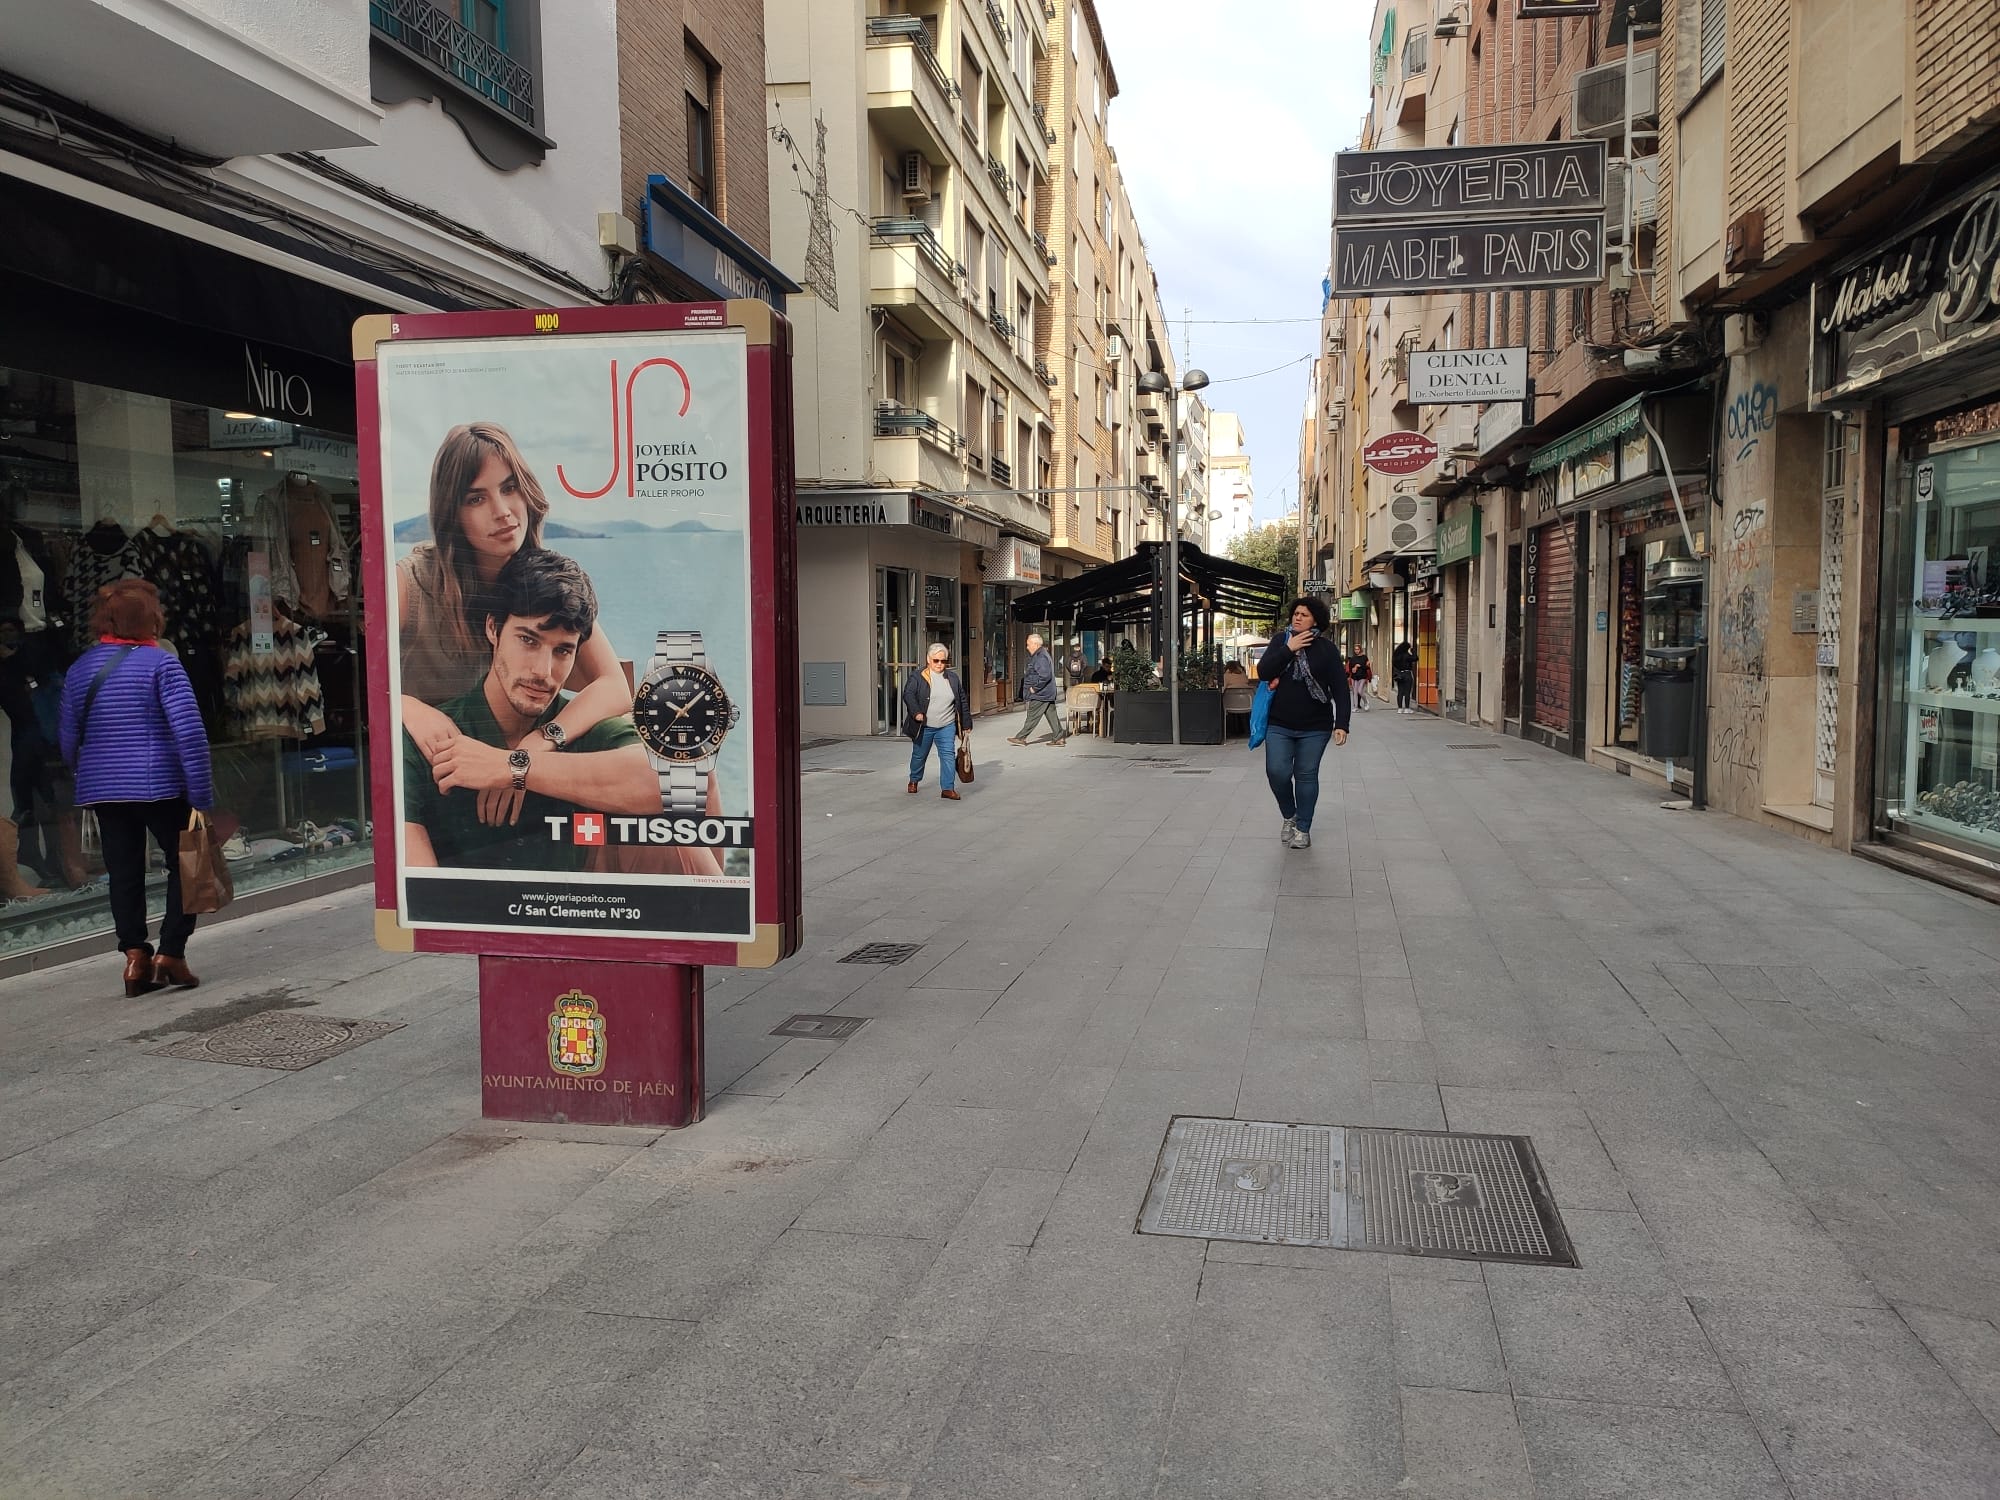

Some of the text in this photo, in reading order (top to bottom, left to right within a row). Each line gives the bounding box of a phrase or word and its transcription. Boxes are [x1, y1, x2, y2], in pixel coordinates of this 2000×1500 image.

[1349, 155, 1590, 207] JOYERIA
[1343, 229, 1592, 287] MABEL PARIS
[1821, 190, 2000, 334] Mabel P
[714, 247, 757, 299] Allianz
[392, 323, 400, 334] B
[535, 313, 559, 329] MODO
[1427, 352, 1508, 369] CLINICA
[245, 340, 313, 417] Nina
[1429, 372, 1507, 388] DENTAL
[1428, 389, 1464, 398] Norberto
[1466, 388, 1498, 397] Eduardo
[1500, 387, 1521, 396] Goya
[635, 441, 697, 459] JOYERÍA
[636, 458, 728, 482] PÓSITO
[636, 488, 705, 498] TALLER PROPIO
[610, 816, 750, 845] TISSOT
[521, 892, 626, 905] www.joyeriaposito.com
[508, 903, 522, 916] C/
[525, 904, 547, 916] San
[549, 905, 607, 918] Clemente
[483, 1075, 675, 1097] AYUNTAMIENTO DE JAÉN
